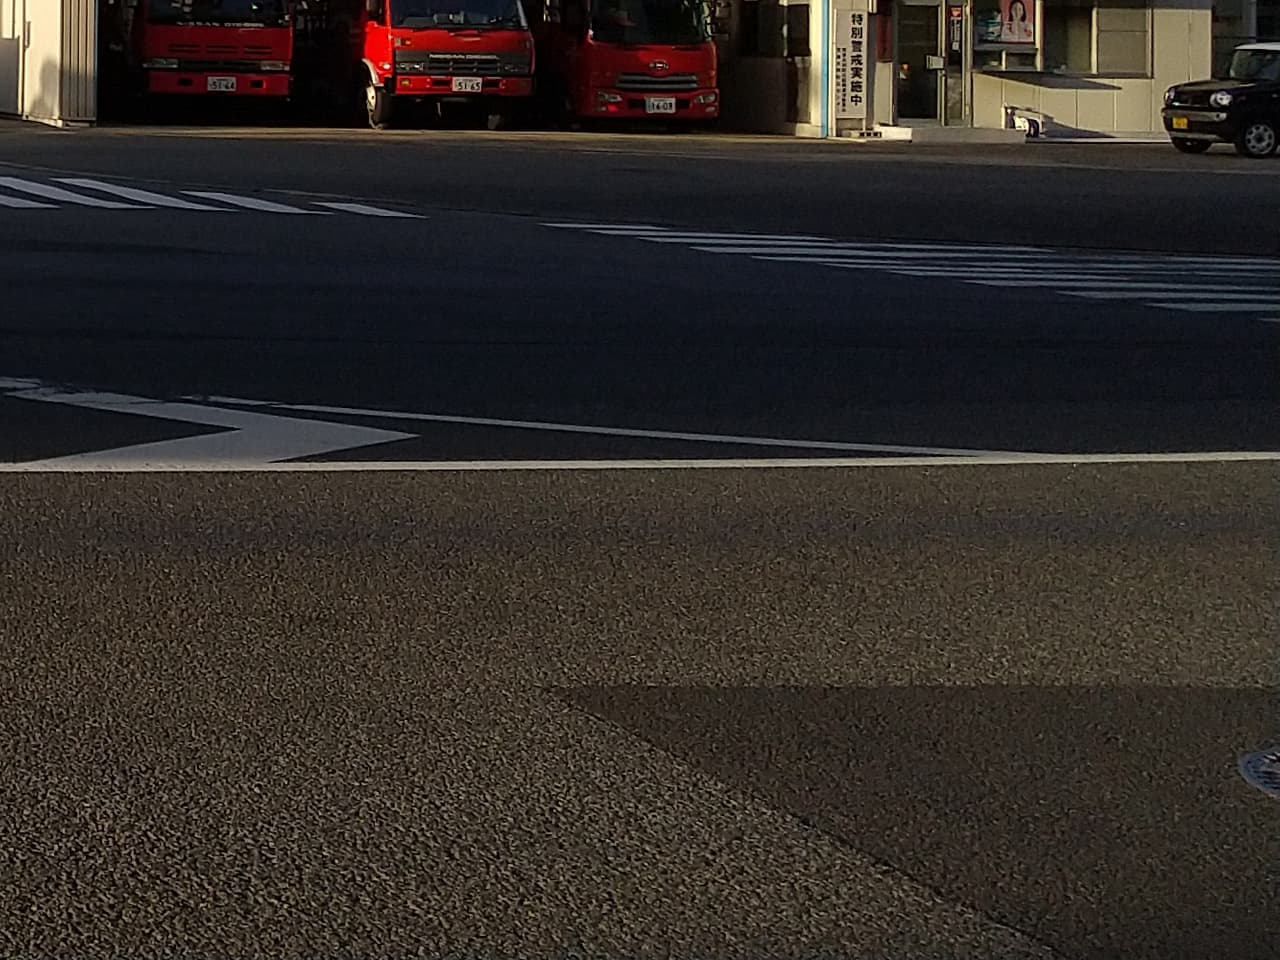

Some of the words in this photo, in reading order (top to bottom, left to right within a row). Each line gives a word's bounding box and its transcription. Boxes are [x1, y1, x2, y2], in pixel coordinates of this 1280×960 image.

[850, 13, 863, 106] 特別警戒実施中
